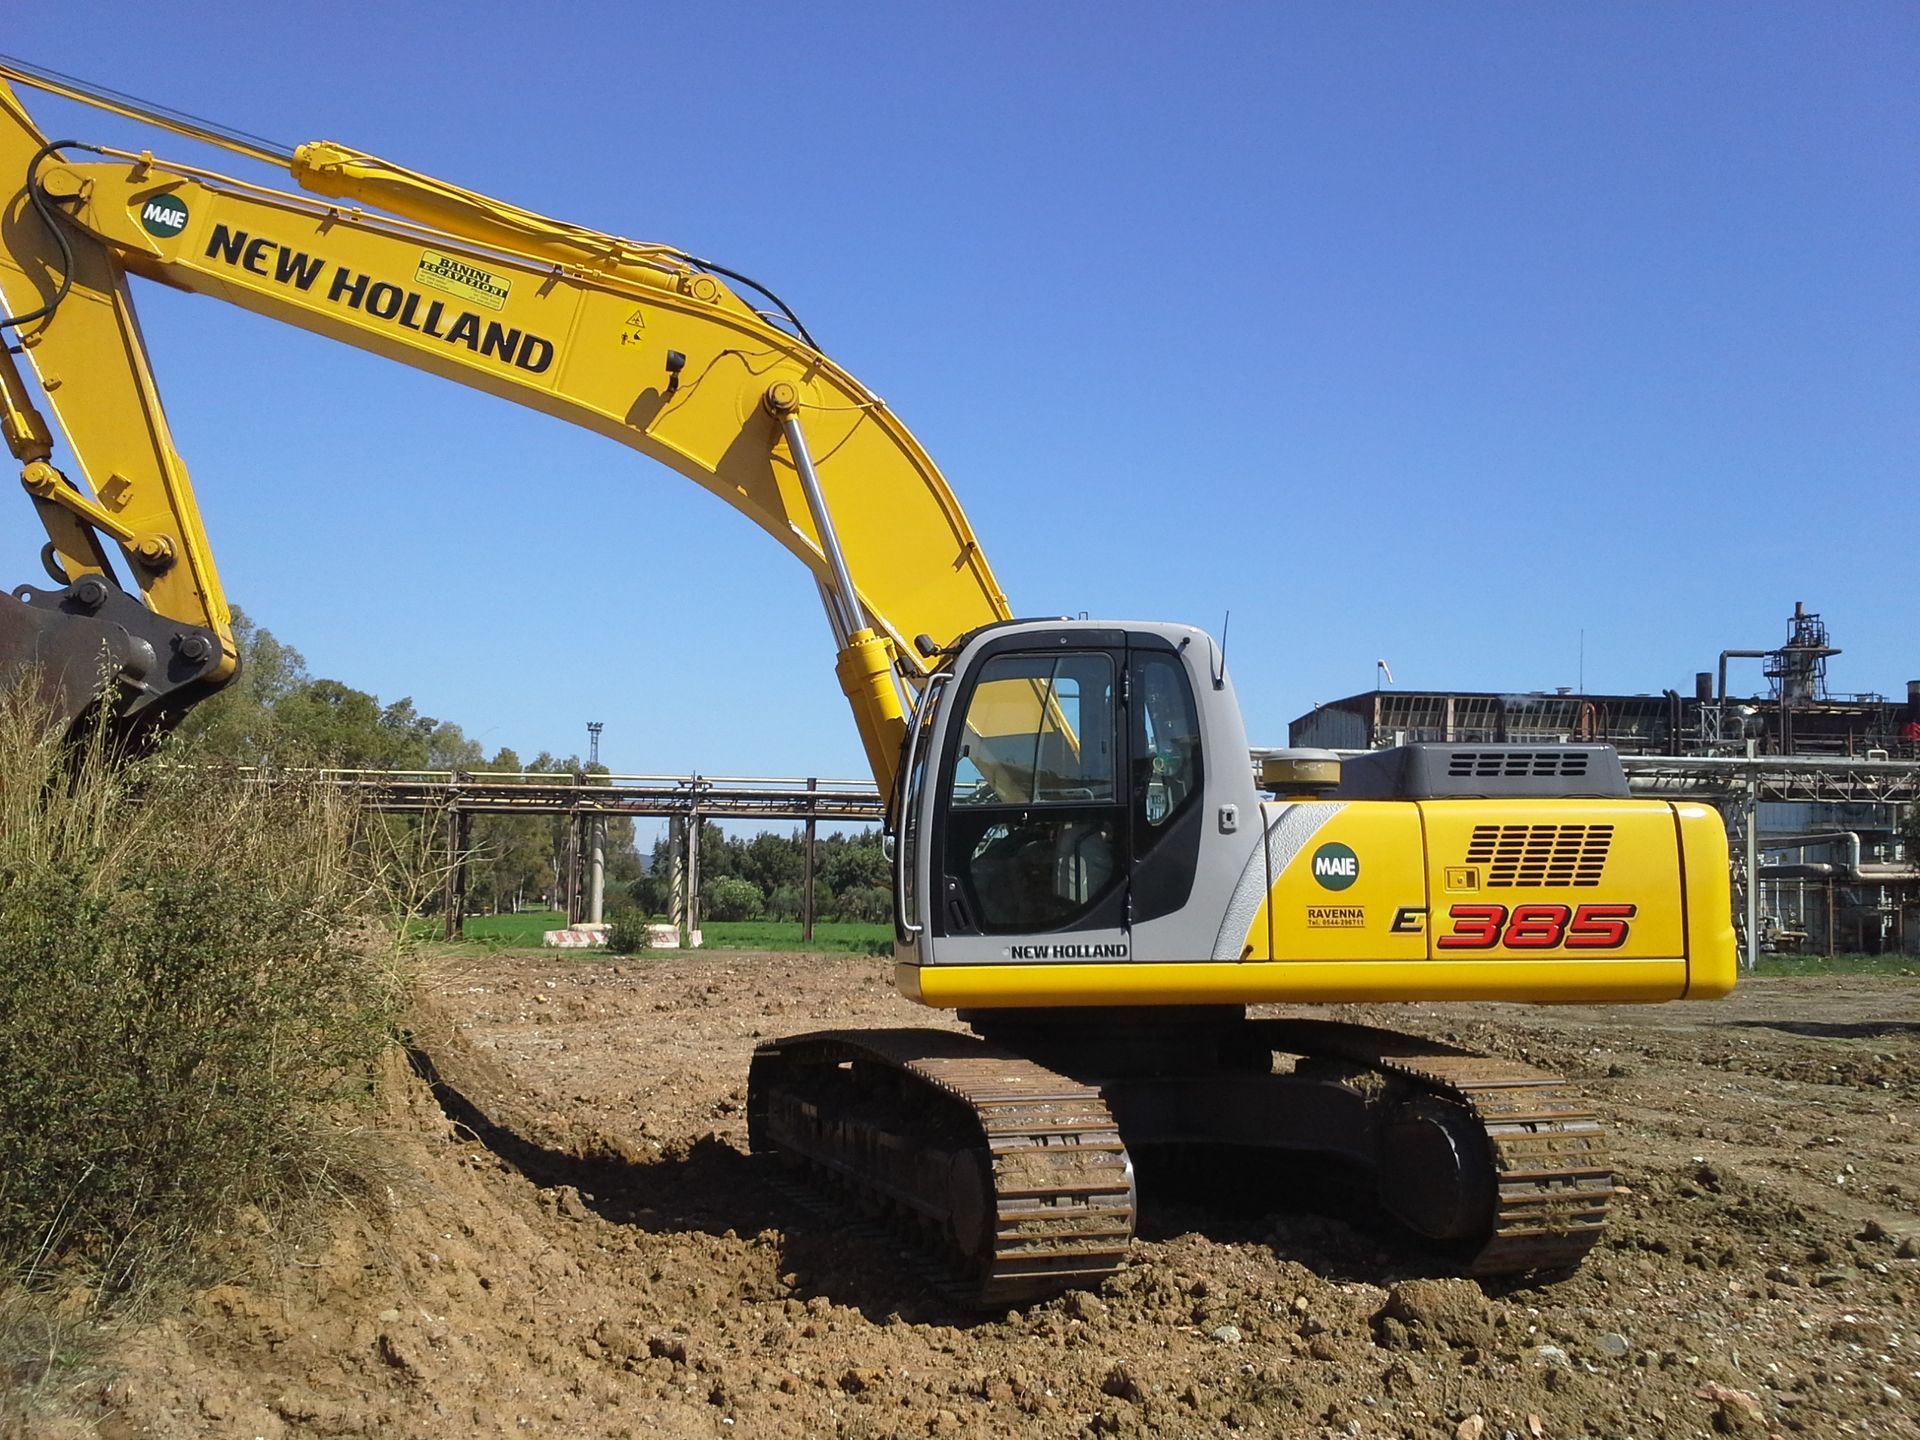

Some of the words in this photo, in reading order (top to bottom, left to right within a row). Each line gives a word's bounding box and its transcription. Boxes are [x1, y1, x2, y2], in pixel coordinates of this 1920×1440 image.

[143, 202, 186, 228] MAIE
[423, 263, 504, 297] ESCAVAZIONI
[438, 258, 493, 284] BANINI
[205, 224, 326, 291] NEW
[328, 266, 554, 375] HOLLAND
[1315, 857, 1356, 876] MAIE
[1308, 909, 1364, 919] RAVENNA
[1437, 904, 1637, 950] 385
[1011, 945, 1049, 959] NEW
[1052, 944, 1128, 958] HOLLAND
